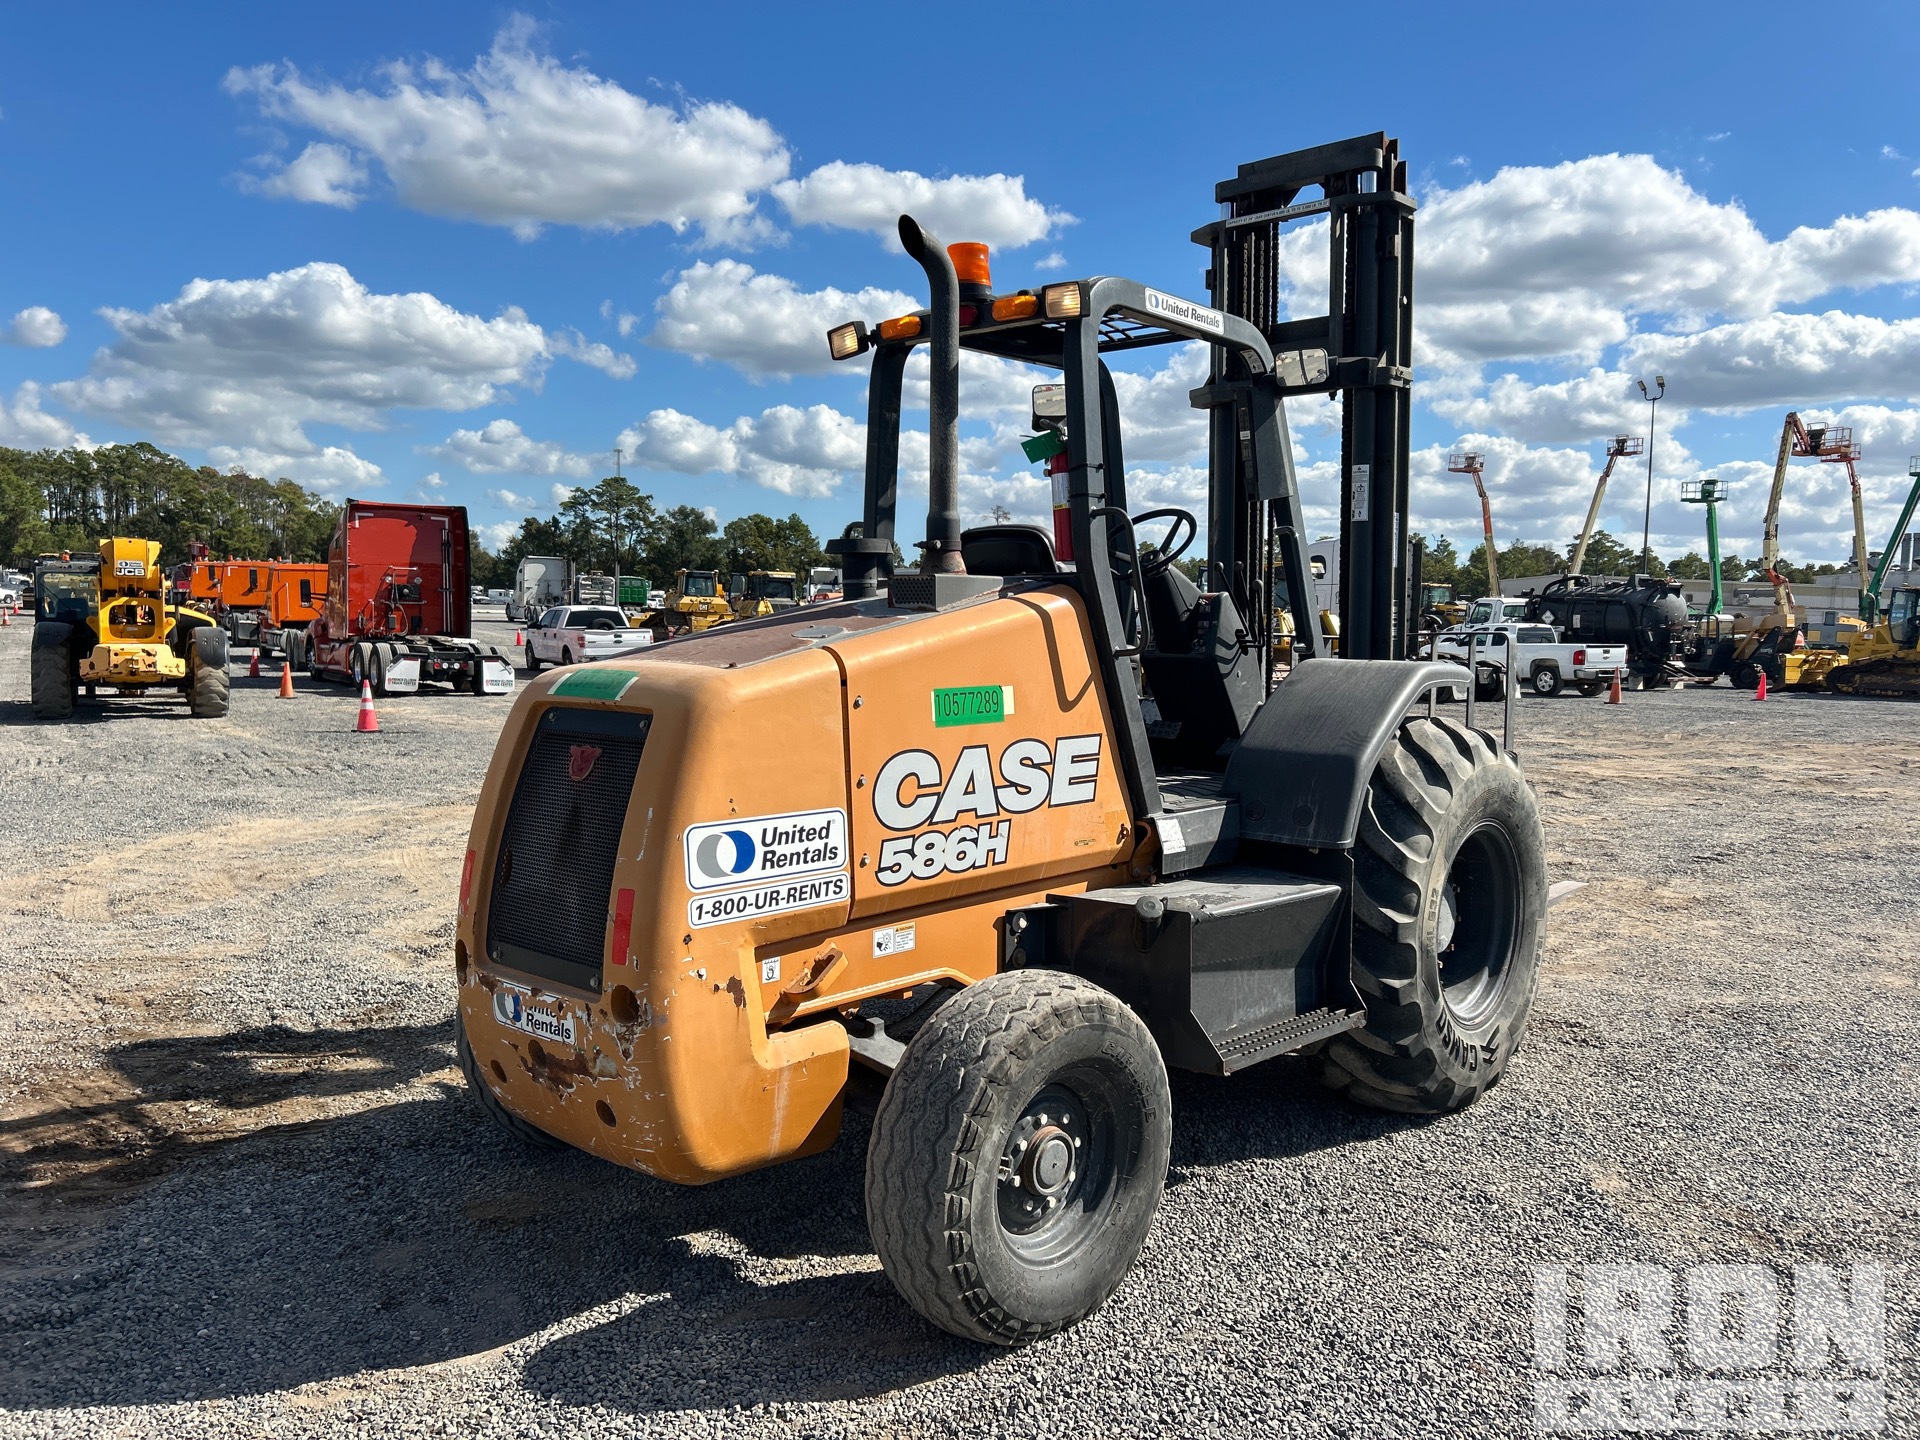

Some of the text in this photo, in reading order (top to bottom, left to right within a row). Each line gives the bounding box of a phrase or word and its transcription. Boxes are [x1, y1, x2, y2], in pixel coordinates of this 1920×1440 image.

[1161, 298, 1220, 328] United Rentals
[116, 568, 145, 576] JCB
[934, 690, 1000, 718] 10577289
[872, 733, 1103, 832] CASE
[761, 819, 832, 848] United
[761, 842, 839, 871] Rentals
[874, 819, 1012, 887] 586H
[694, 878, 844, 921] 1-800-UR-RENTS
[526, 1012, 572, 1040] Rentals
[1436, 1009, 1479, 1073] CAMSO
[1102, 1040, 1157, 1122] CARLISLE
